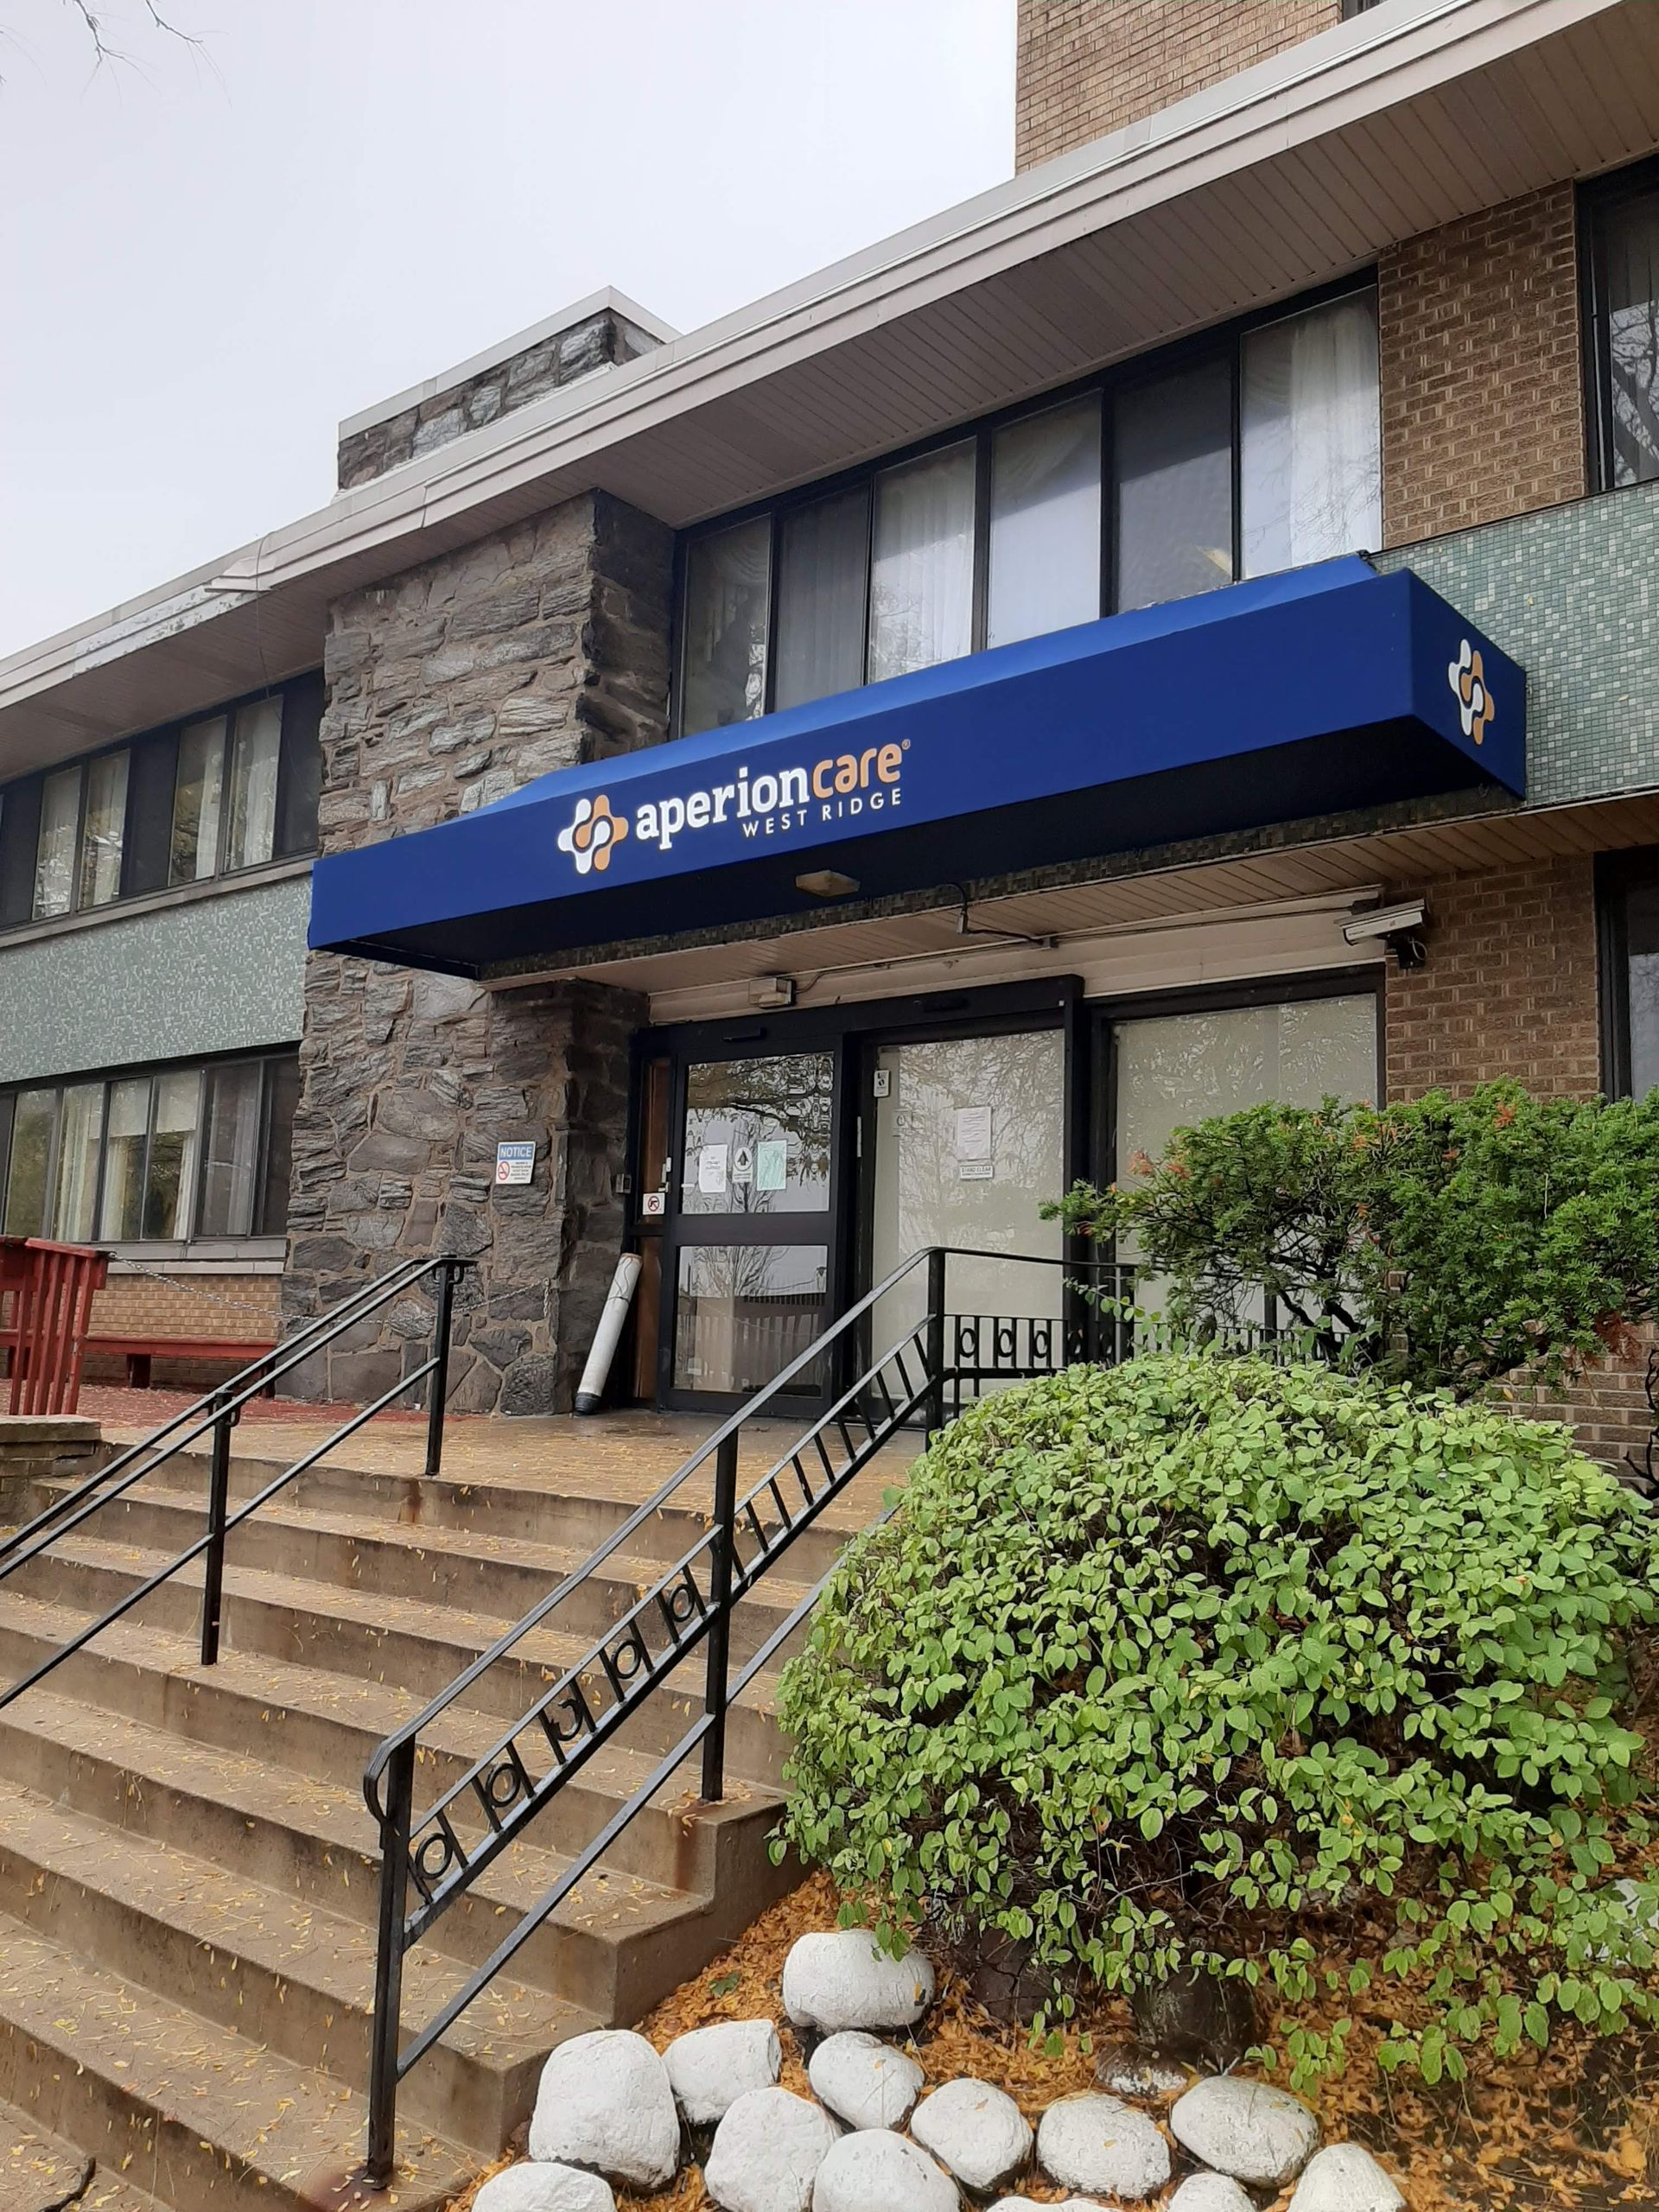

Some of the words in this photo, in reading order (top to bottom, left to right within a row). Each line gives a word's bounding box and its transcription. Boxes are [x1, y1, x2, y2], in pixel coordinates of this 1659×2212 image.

[742, 809, 808, 838] WEST
[822, 788, 902, 822] RIDGE
[499, 1146, 532, 1158] NOTICE
